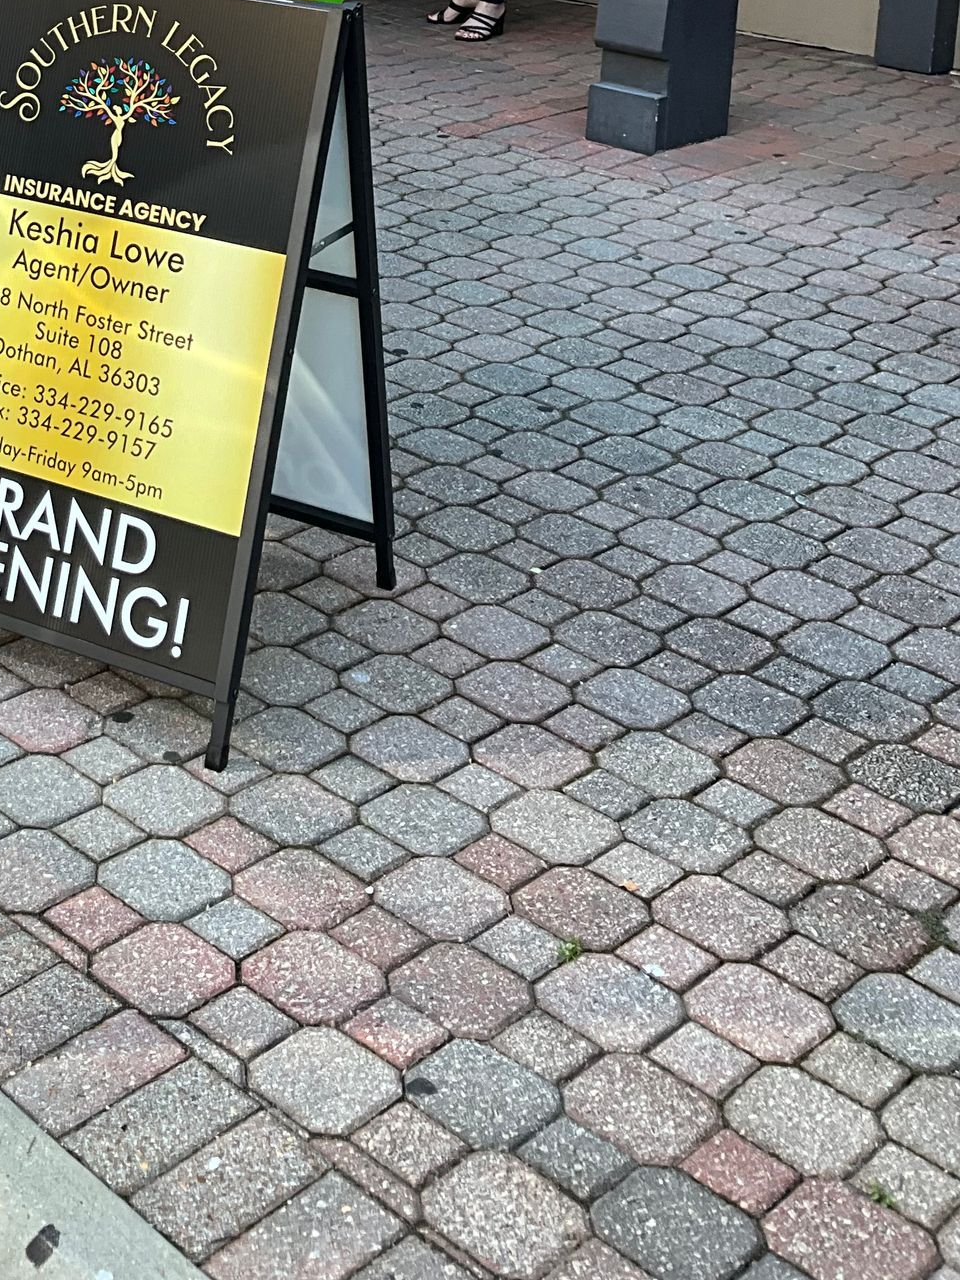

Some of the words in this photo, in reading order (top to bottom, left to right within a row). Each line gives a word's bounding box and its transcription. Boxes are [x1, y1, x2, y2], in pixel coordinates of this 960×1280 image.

[161, 21, 234, 155] LEGACY
[3, 175, 117, 214] INSURANCE
[118, 199, 206, 232] AGENCY
[9, 208, 99, 254] Keshia
[110, 230, 184, 273] Lowe
[12, 248, 170, 303] Agent/Owner
[18, 291, 68, 320] North
[76, 305, 132, 335] Foster
[138, 320, 193, 350] Street
[35, 321, 79, 349] Suite
[90, 334, 122, 360] 108
[68, 357, 91, 378] AL
[98, 364, 160, 396] 36303
[17, 406, 156, 460] 334-229-9157
[34, 384, 173, 438] 334-229-9165
[82, 461, 162, 500] 9am-5pm
